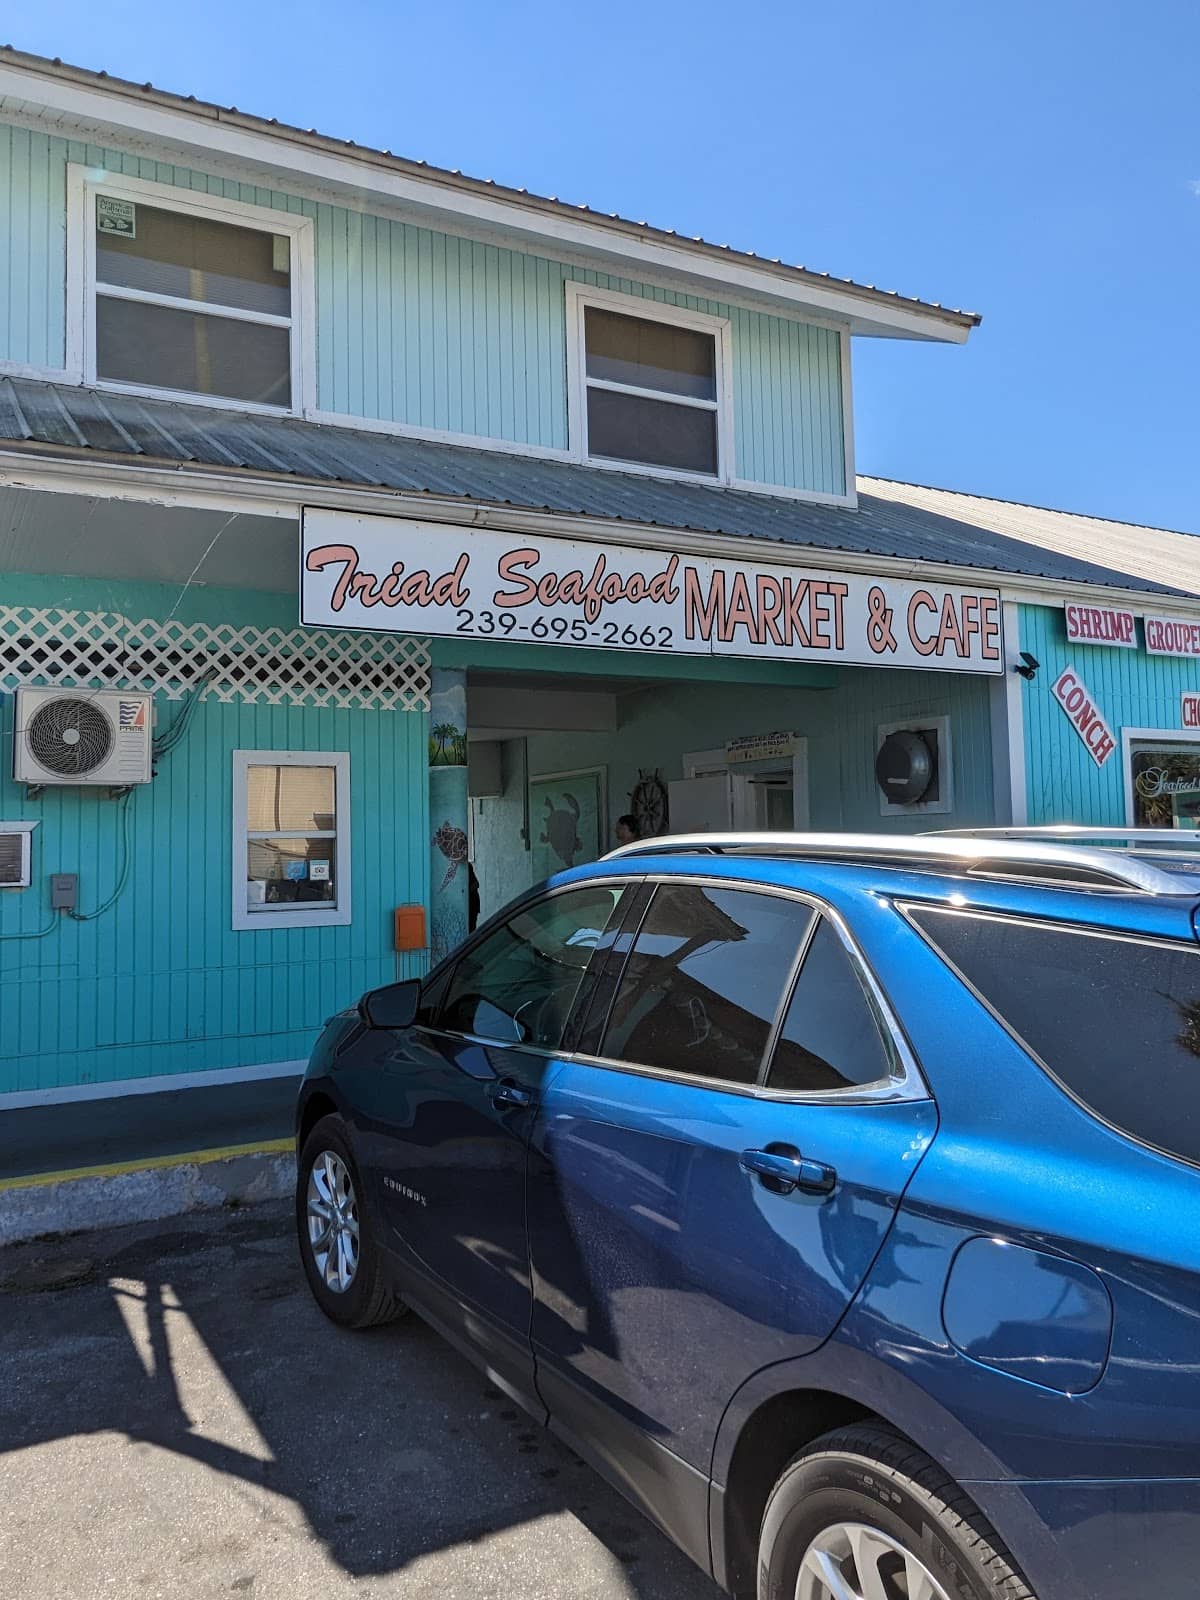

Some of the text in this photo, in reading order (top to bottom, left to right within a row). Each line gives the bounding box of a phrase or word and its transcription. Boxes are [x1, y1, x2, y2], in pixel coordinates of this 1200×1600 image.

[306, 544, 680, 623] Triad Seafood
[456, 609, 673, 648] 239-695-2662
[684, 567, 999, 660] MARKET & CAFE
[1067, 606, 1133, 643] SHRIMP
[1146, 619, 1200, 654] GROUPE
[1056, 673, 1114, 764] CONCH
[1135, 767, 1197, 798] Seafood
[383, 1176, 427, 1207] EQUINOX
